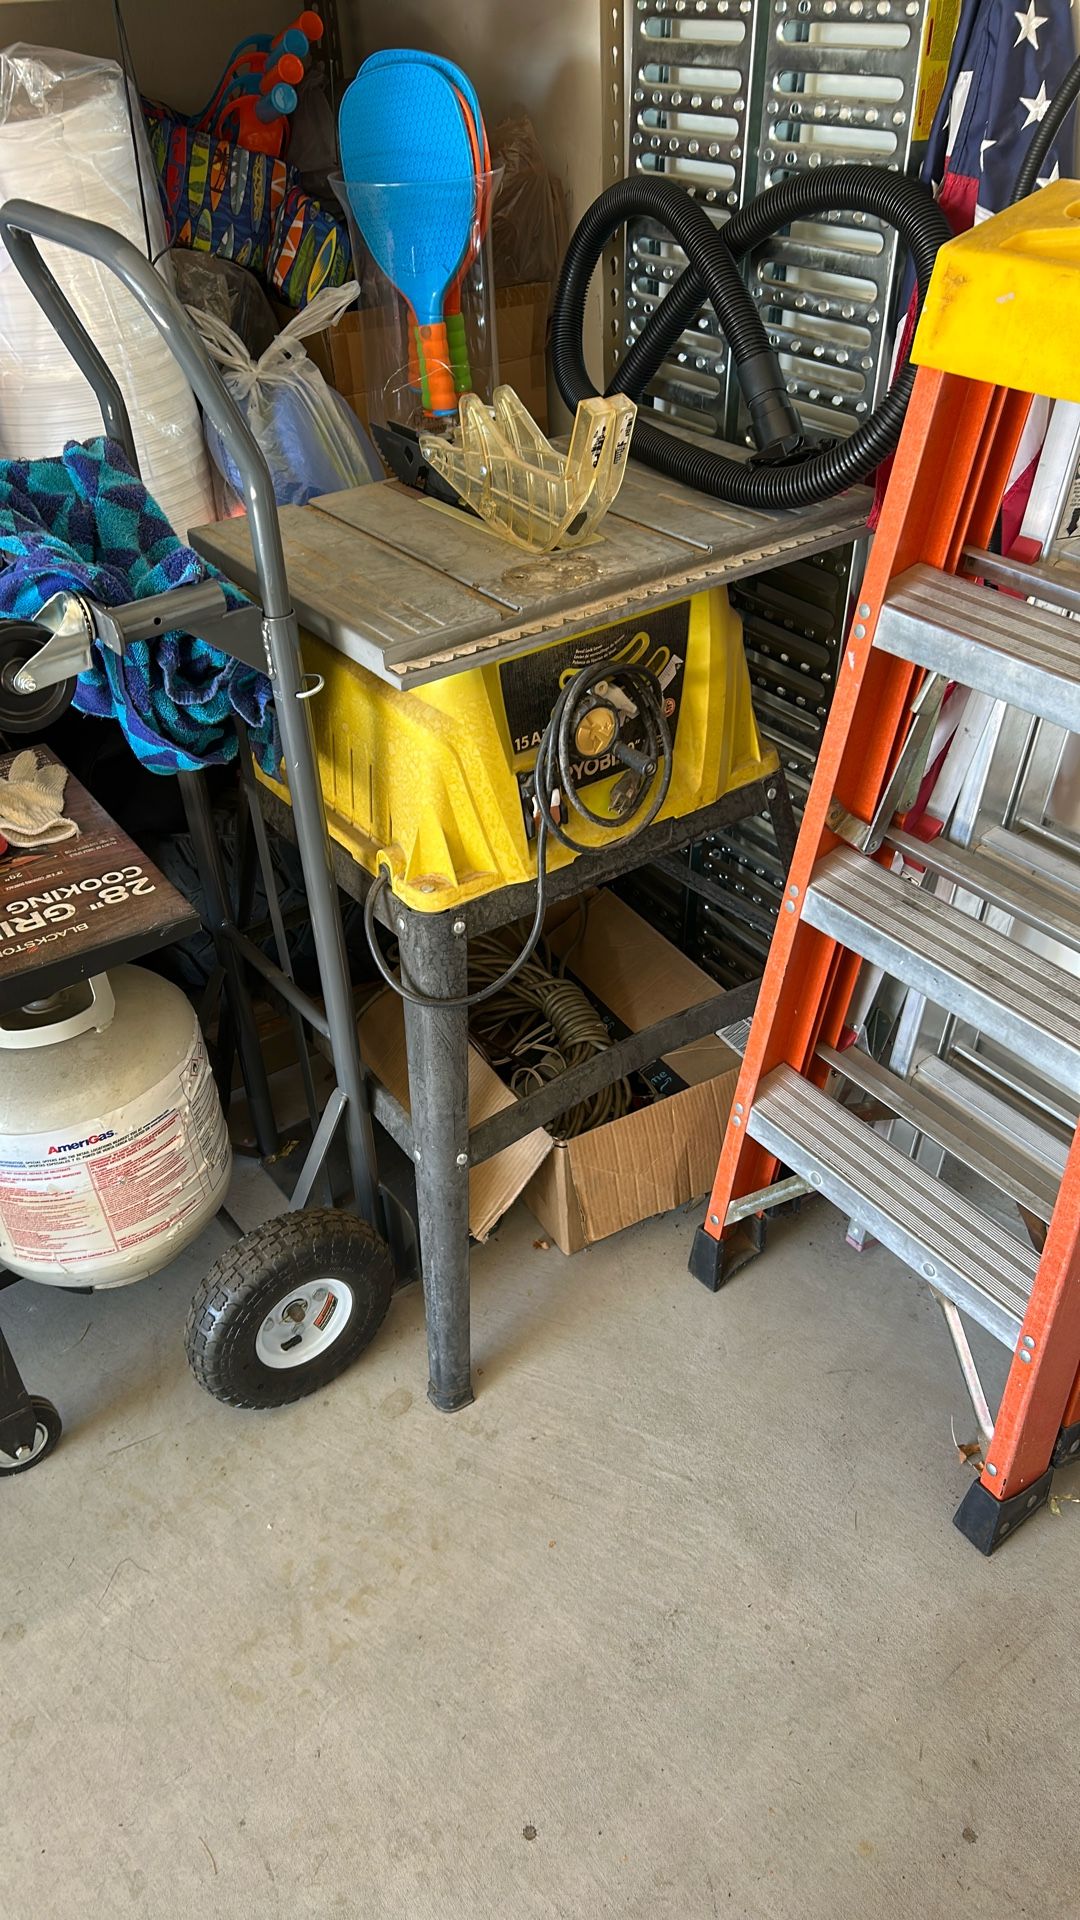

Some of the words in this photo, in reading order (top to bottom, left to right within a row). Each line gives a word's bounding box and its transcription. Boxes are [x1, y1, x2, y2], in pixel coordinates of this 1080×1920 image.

[514, 735, 530, 751] 15
[6, 865, 143, 915] COOKING
[89, 876, 157, 911] 28"
[0, 902, 76, 941] GRI
[0, 922, 89, 958] BLACKSTO
[47, 1129, 115, 1155] AmeriGas
